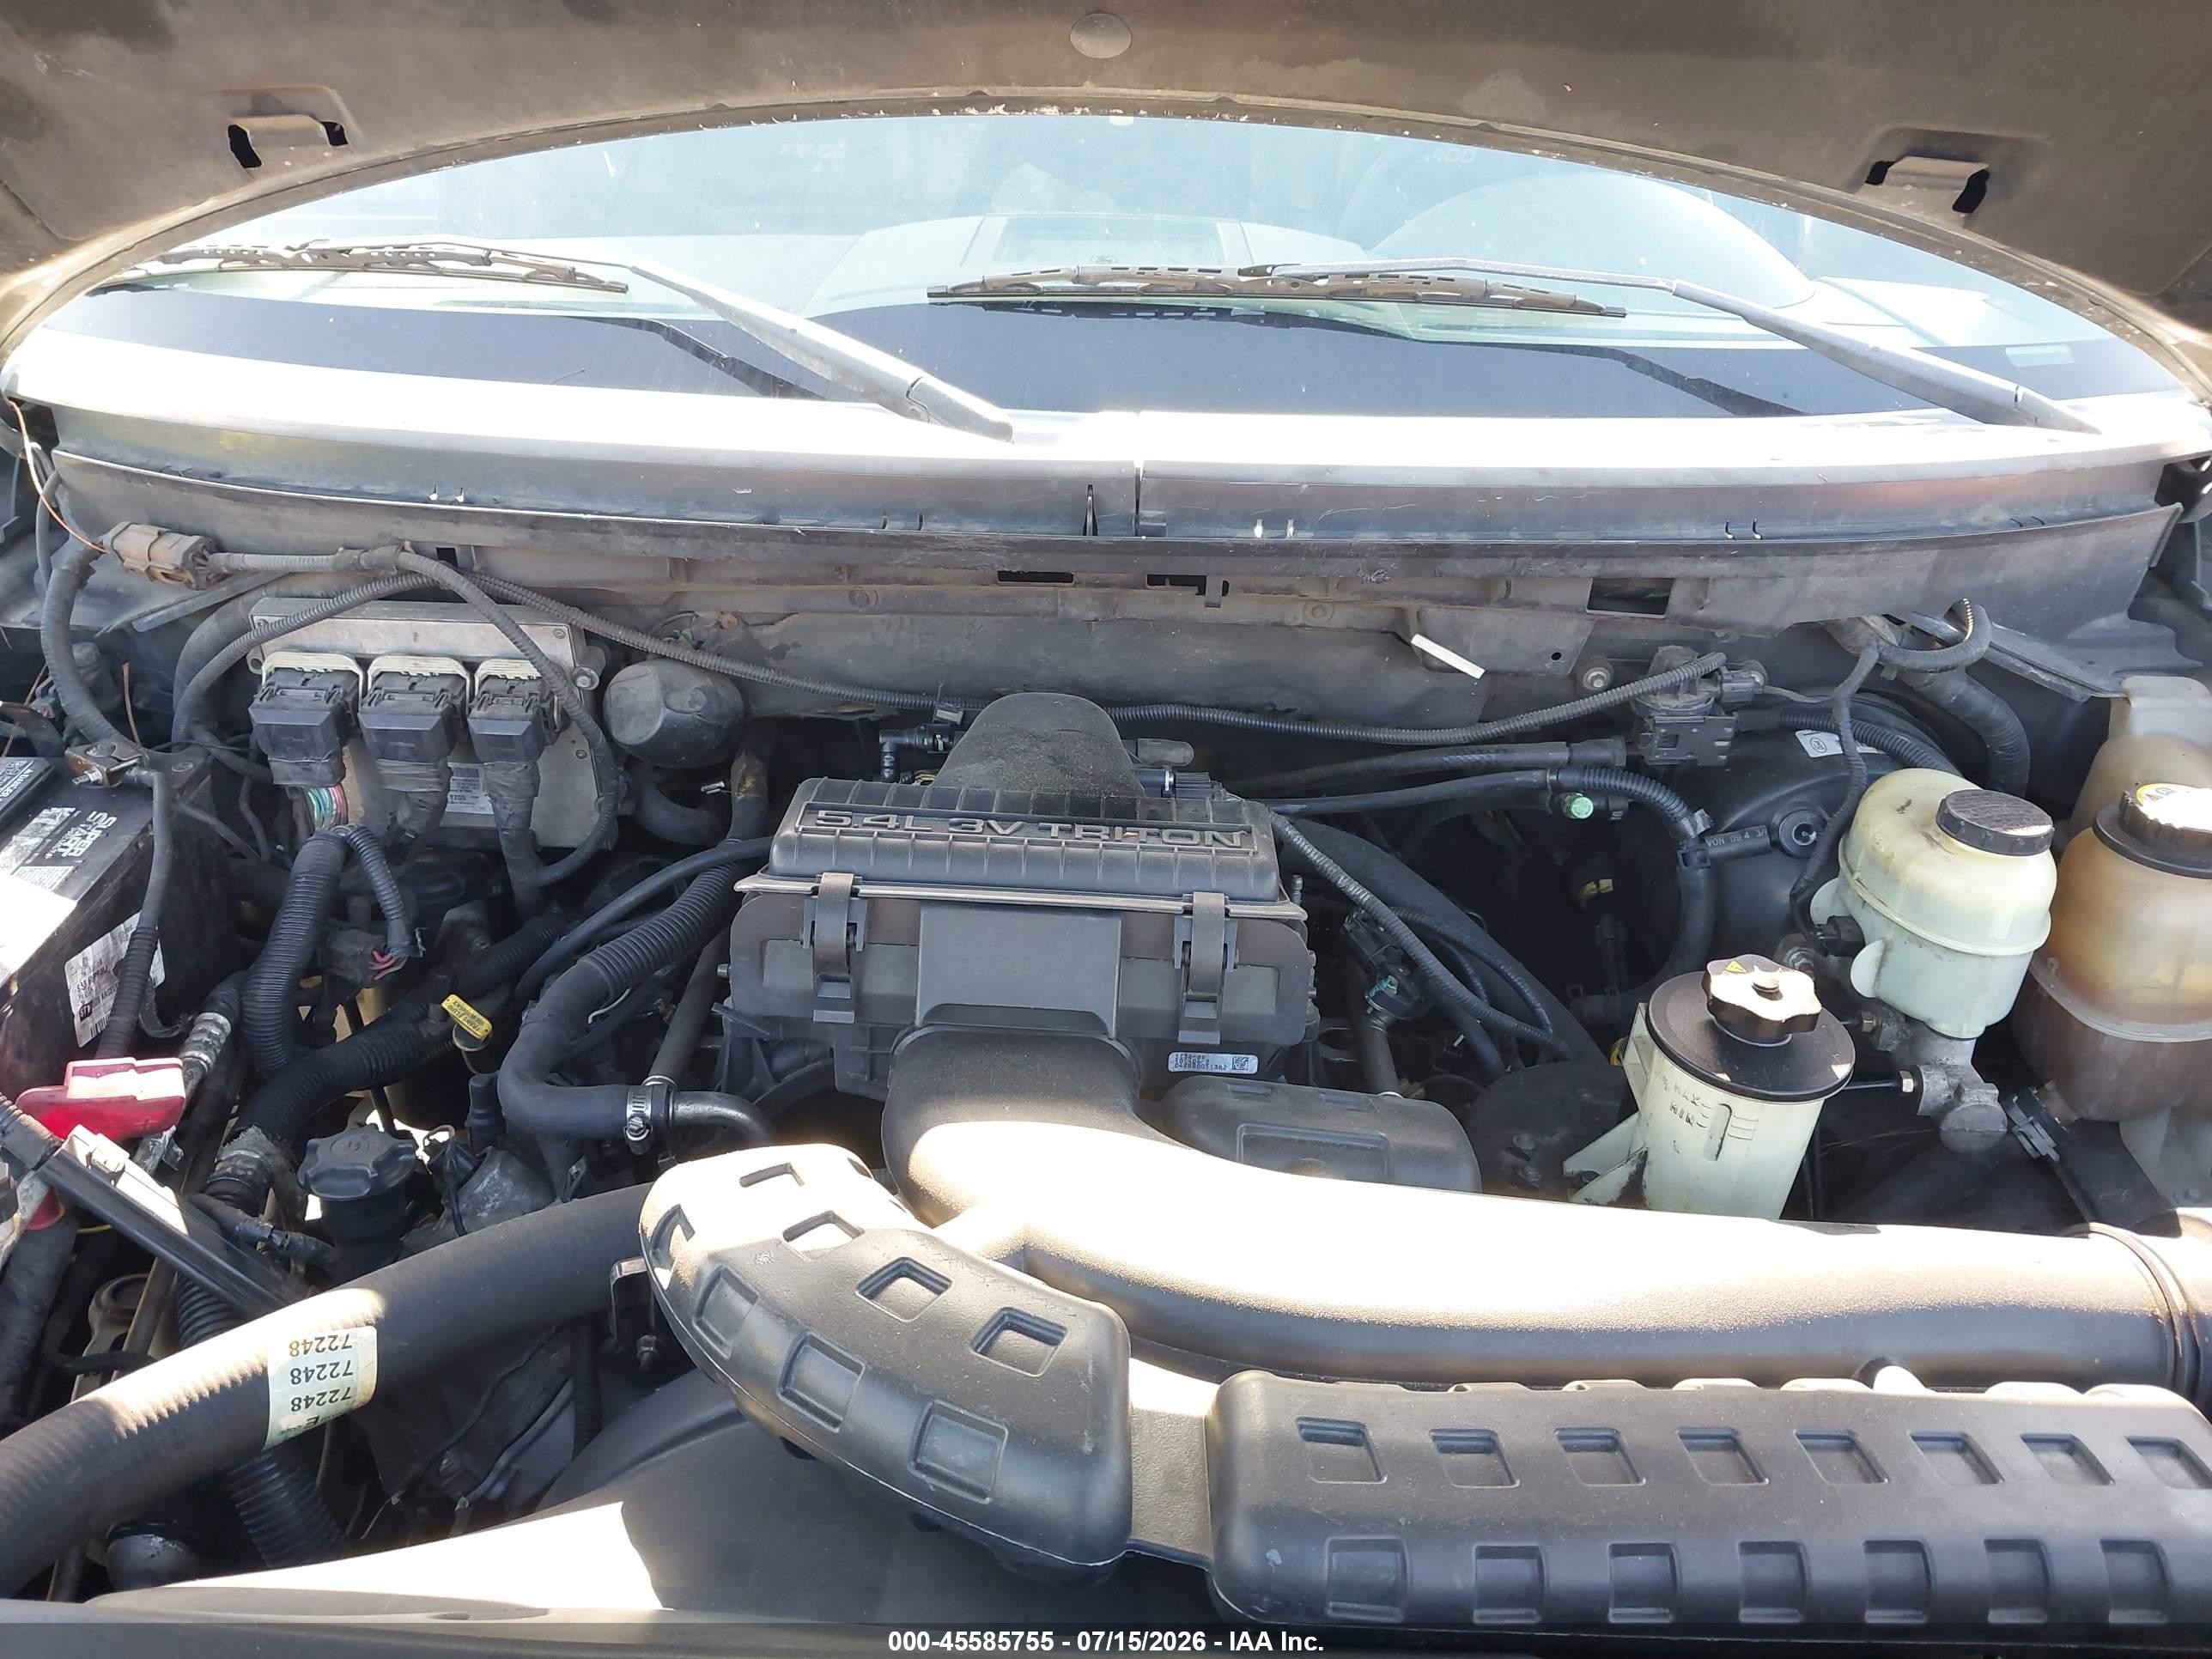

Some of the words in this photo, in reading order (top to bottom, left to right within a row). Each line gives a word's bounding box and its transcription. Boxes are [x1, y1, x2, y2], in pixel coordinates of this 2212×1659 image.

[57, 811, 108, 858] START
[69, 815, 118, 857] SUPER
[816, 810, 933, 831] 5.4L
[948, 818, 1024, 836] 3V
[1038, 822, 1253, 848] TRITON
[289, 1334, 352, 1358] 72248
[289, 1359, 353, 1385] 72248
[290, 1387, 351, 1413] 72248
